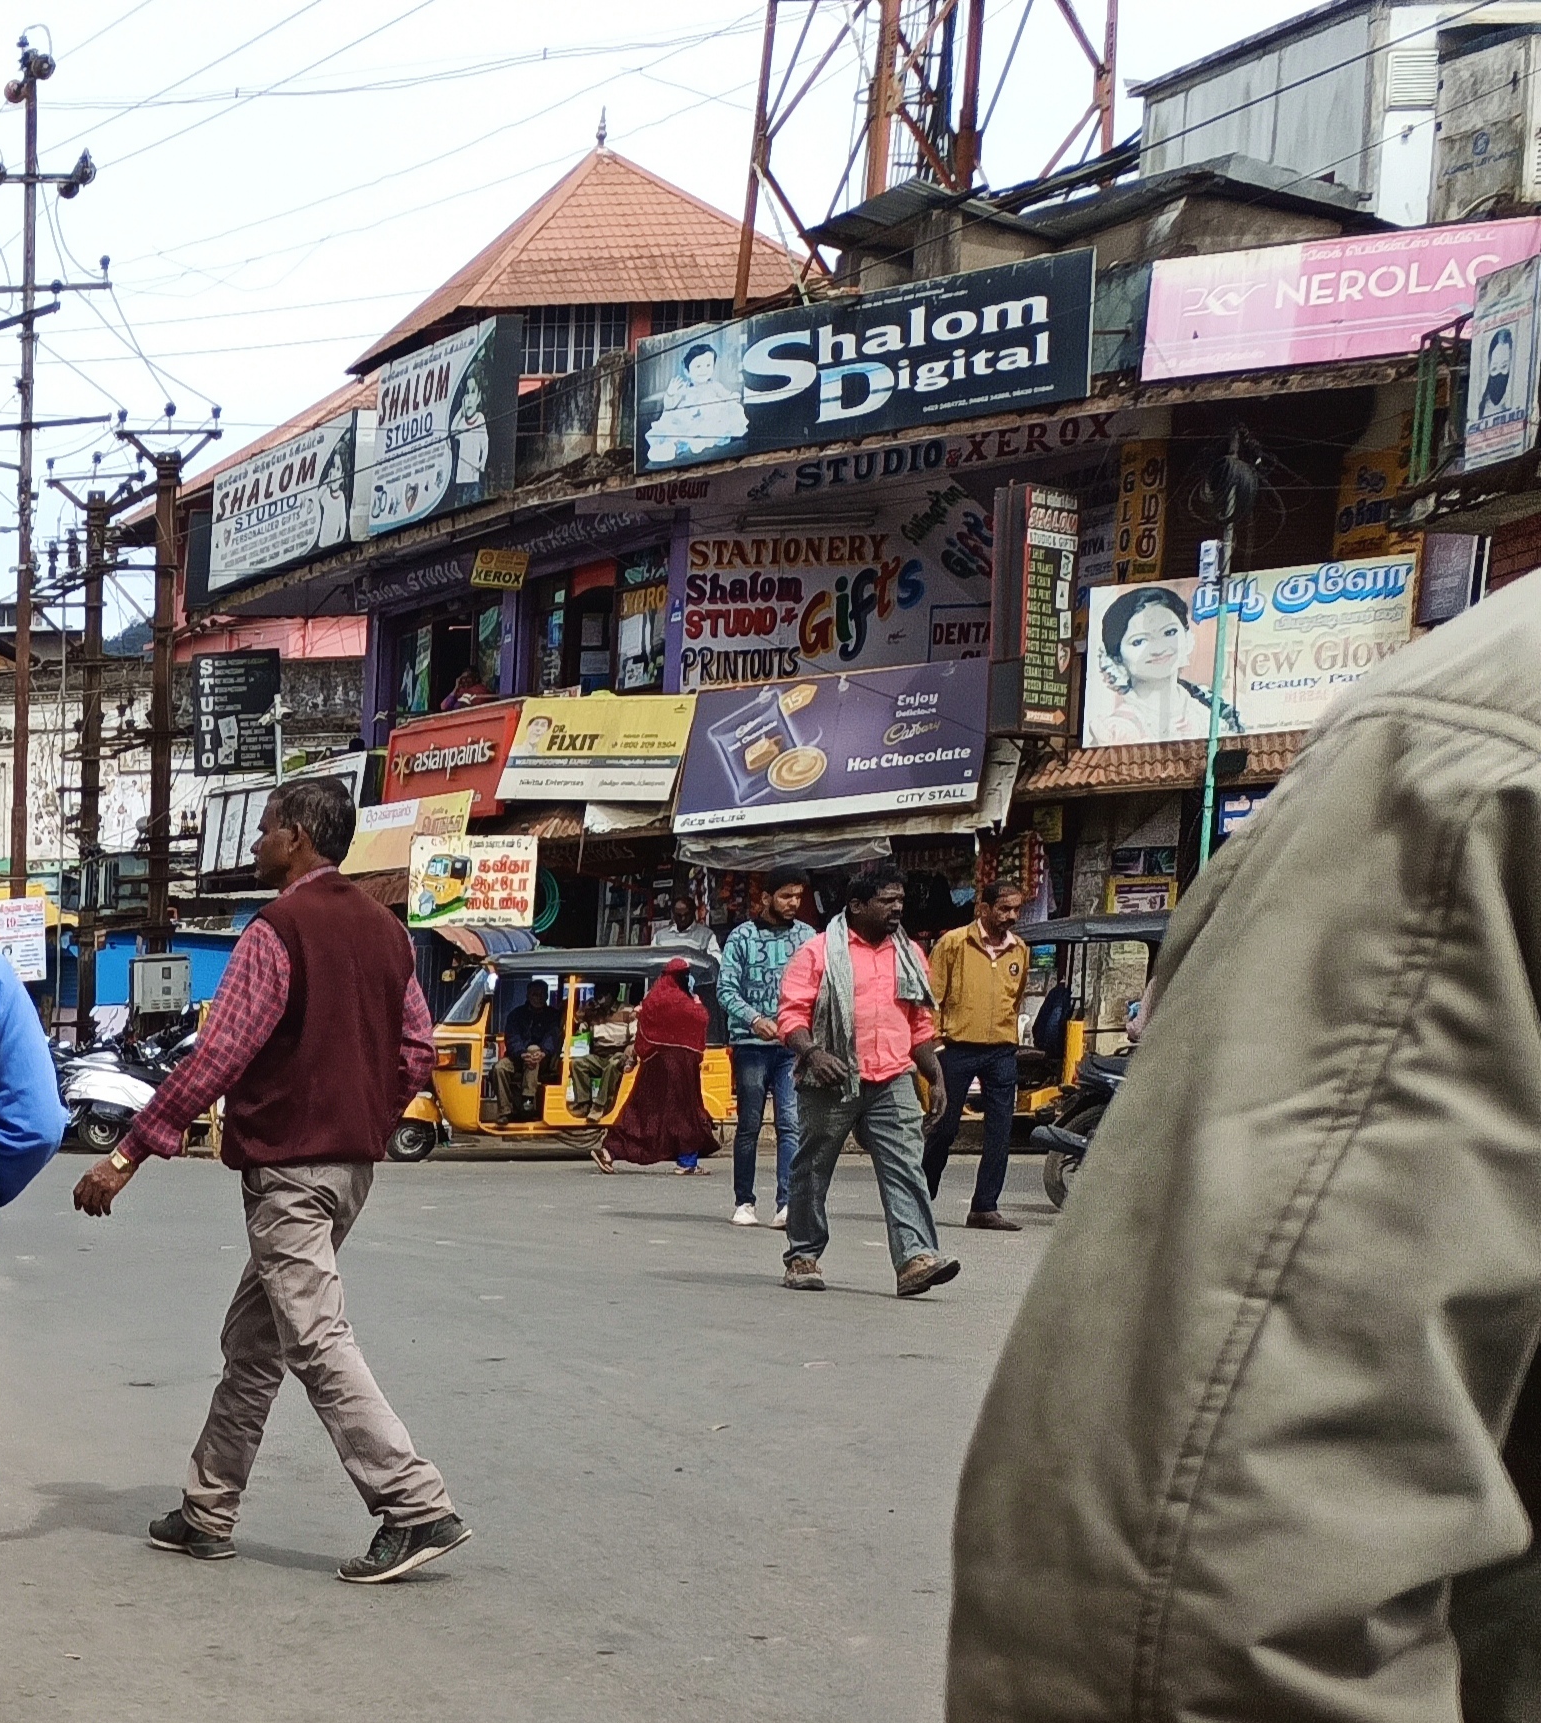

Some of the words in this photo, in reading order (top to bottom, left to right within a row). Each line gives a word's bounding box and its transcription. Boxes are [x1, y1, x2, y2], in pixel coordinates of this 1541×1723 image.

[1275, 254, 1500, 309] NEROLAC
[741, 294, 1049, 404] Shalom
[378, 361, 451, 428] SHALOM
[816, 331, 1051, 424] Digital
[385, 411, 433, 449] STUDIO
[795, 440, 946, 492] STUDIO
[964, 412, 1116, 463] XEROX
[216, 451, 318, 522] SHALOM
[234, 494, 298, 532] STUDIO
[1028, 507, 1078, 533] SHALOM
[688, 533, 890, 570] STATIONERY
[406, 560, 465, 591] STUDIO
[472, 568, 523, 586] XEROX
[685, 571, 804, 607] Shalom
[685, 607, 778, 641] STUDIO
[799, 555, 926, 661] Gifts
[681, 645, 802, 687] PRINTOUTS
[1225, 642, 1305, 681] New
[897, 691, 939, 708] Enjoy
[1250, 674, 1322, 691] Beauty
[199, 659, 215, 768] STUDIO
[552, 724, 568, 734] DR.
[546, 734, 601, 751] FIXIT
[882, 720, 942, 746] Cadbury
[414, 737, 496, 781] asianpaints
[846, 756, 879, 772] Hot
[880, 746, 972, 768] Chocolate
[896, 791, 925, 804] CITY
[927, 787, 967, 801] STALL
[477, 854, 531, 875] கவிதா
[470, 875, 529, 895] ஆட்டோ
